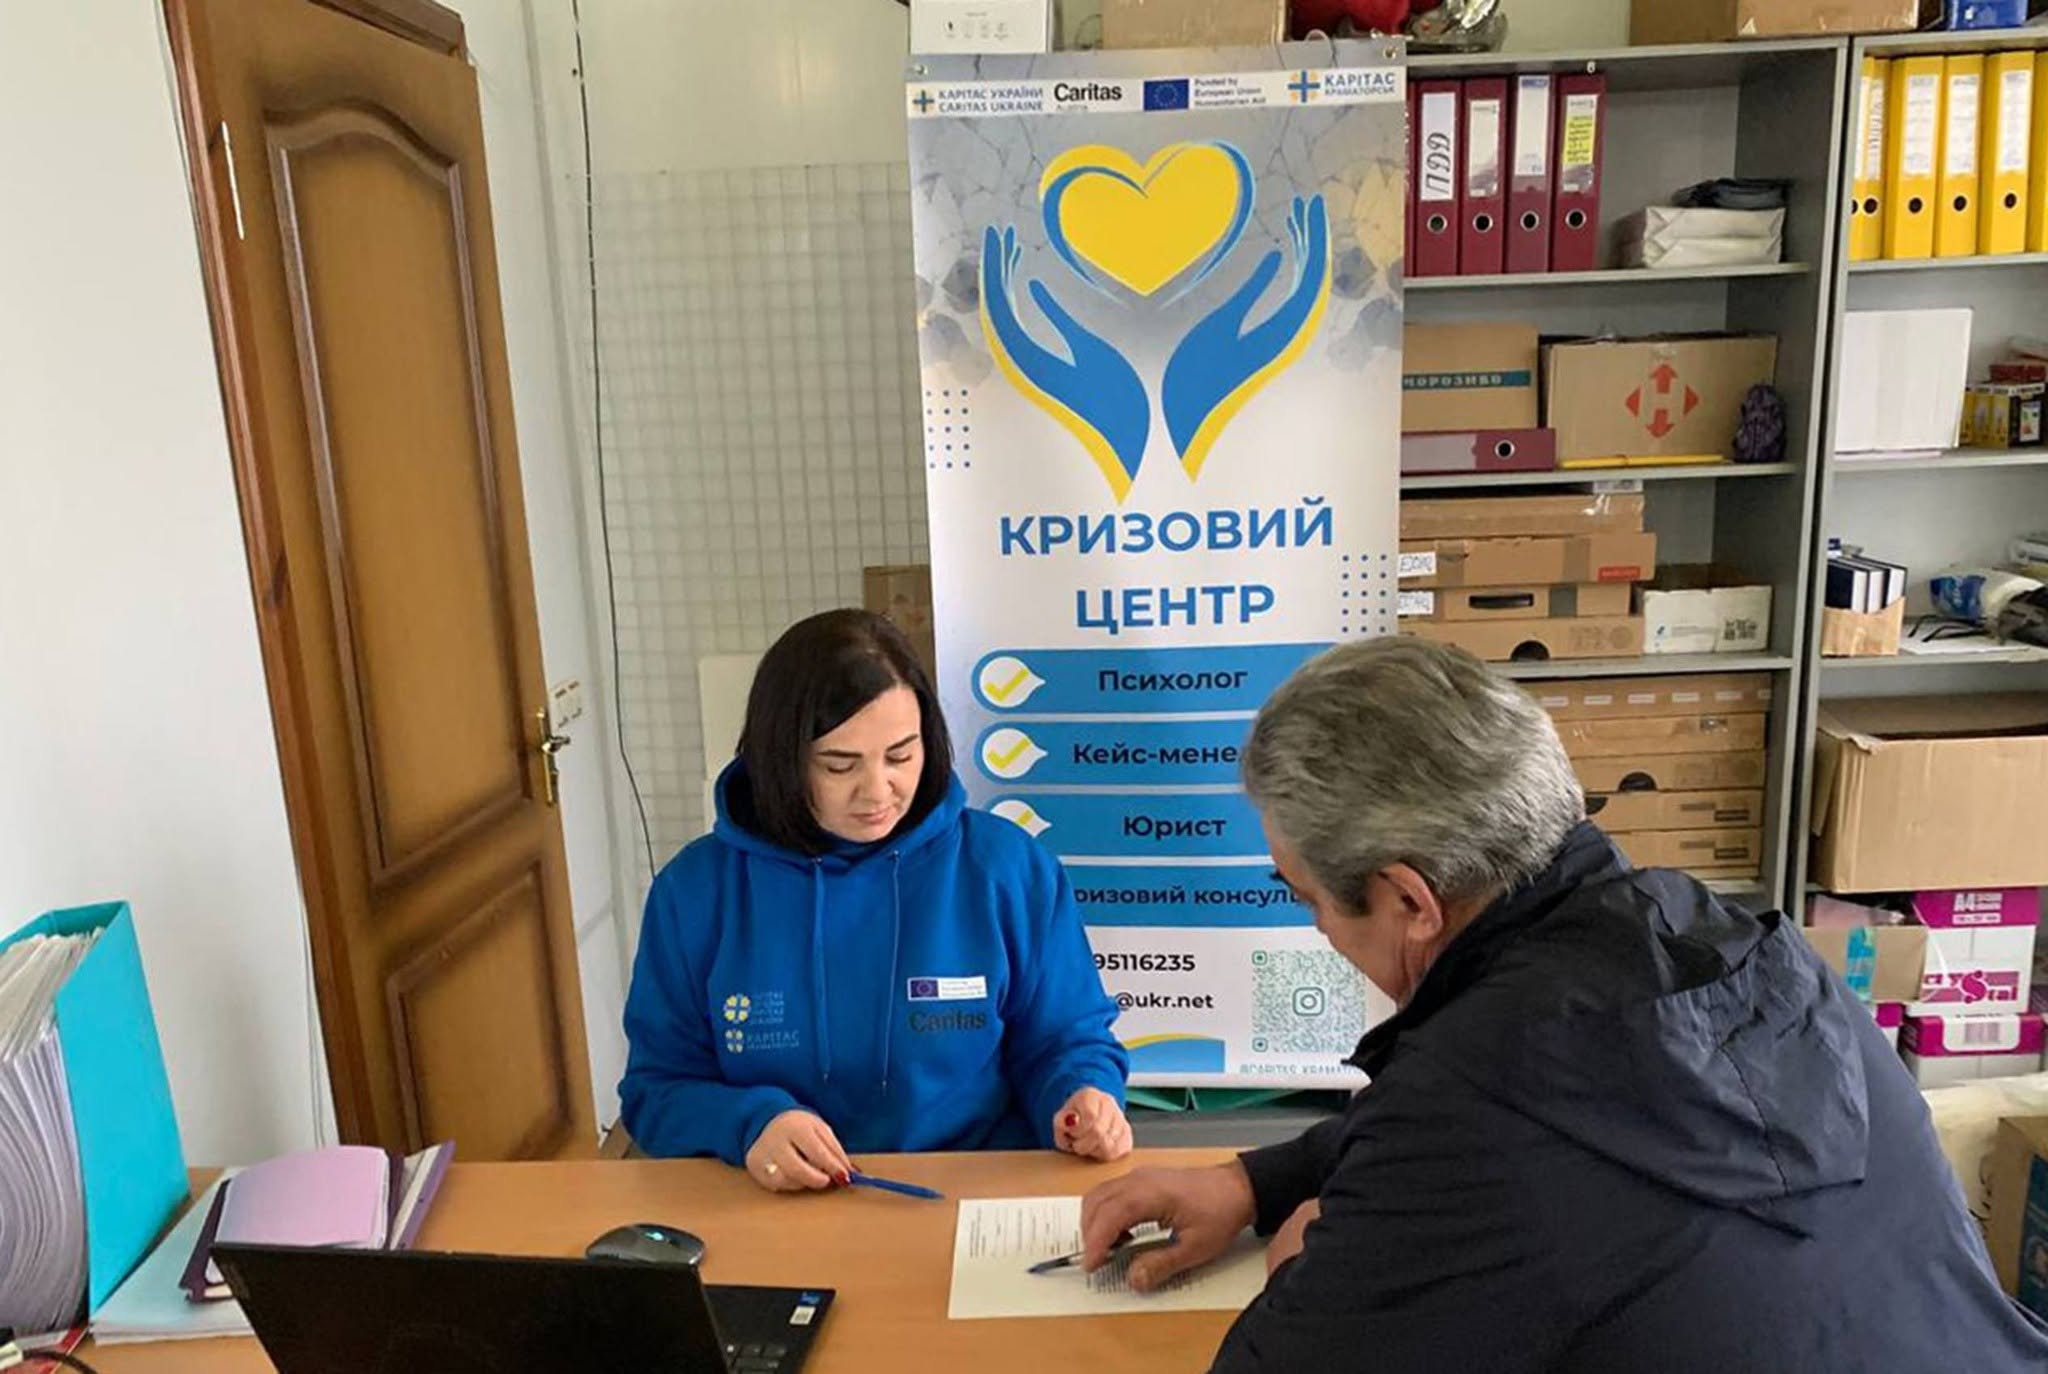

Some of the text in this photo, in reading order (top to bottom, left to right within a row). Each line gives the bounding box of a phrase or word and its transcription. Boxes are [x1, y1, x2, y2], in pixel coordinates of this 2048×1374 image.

[1325, 72, 1396, 86] КАРІТАС
[938, 86, 1043, 100] КАРІТАС УКРАЇНИ
[1054, 83, 1122, 102] Caritas
[939, 101, 987, 113] CARITAS
[991, 99, 1043, 112] UKRAINE
[1000, 496, 1333, 556] КРИЗОВИЙ
[1076, 584, 1275, 635] ЦЕНТР
[1099, 670, 1248, 692] Психолог
[1073, 742, 1240, 765] Кейс-мене
[1123, 815, 1227, 841] Юрист
[1074, 884, 1186, 905] ризовий
[1092, 952, 1196, 972] 95116235
[1116, 991, 1214, 1012] @ukr.net
